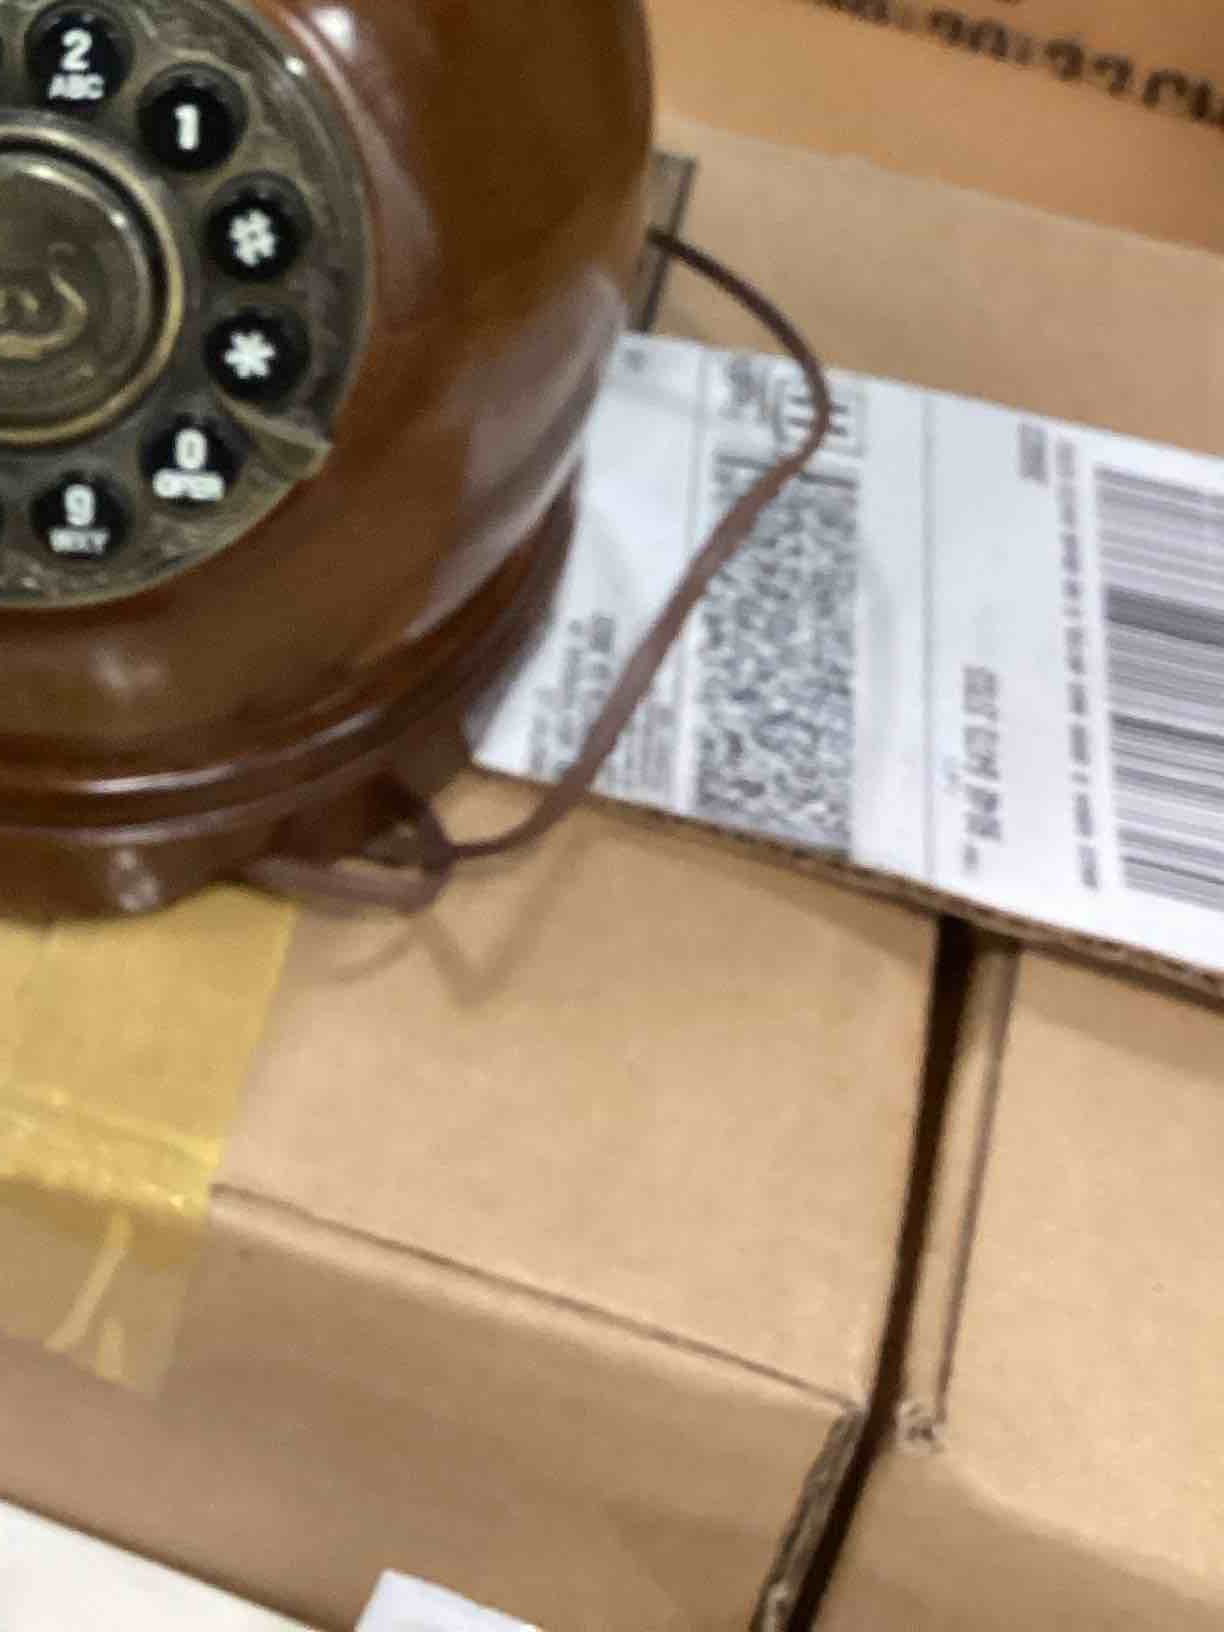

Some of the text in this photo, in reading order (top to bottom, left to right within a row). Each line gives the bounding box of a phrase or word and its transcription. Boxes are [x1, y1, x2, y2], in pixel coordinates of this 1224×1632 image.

[60, 28, 93, 71] 2
[174, 103, 200, 150] 1
[176, 428, 207, 470] 0
[64, 483, 95, 527] 9
